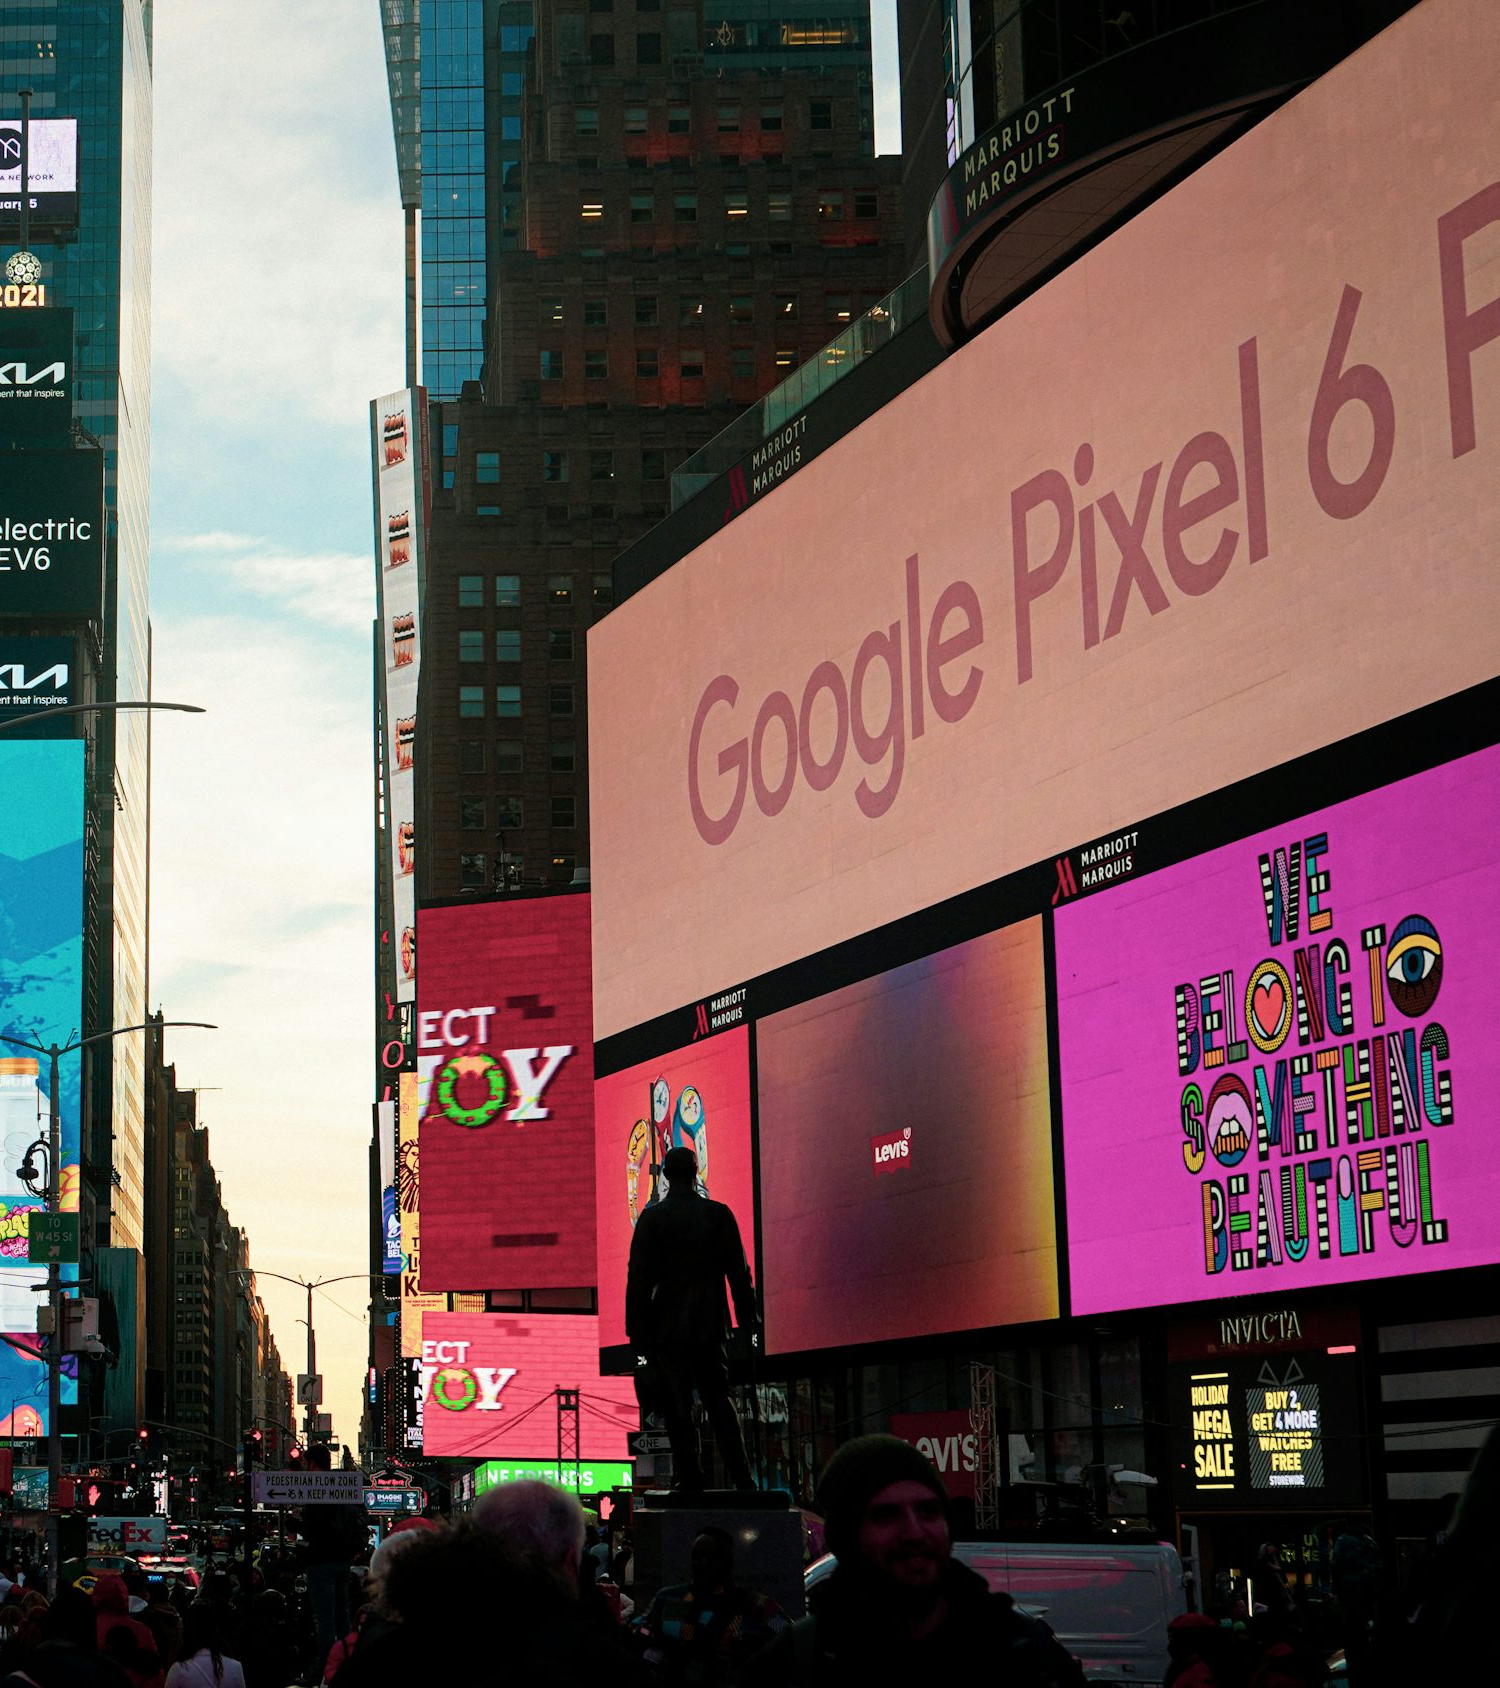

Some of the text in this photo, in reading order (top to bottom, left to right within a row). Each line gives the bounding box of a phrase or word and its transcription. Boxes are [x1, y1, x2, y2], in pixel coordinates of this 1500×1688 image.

[964, 88, 1076, 183] MARRIOTT
[8, 173, 55, 182] NEWORK
[966, 133, 1061, 217] MARQUIS
[29, 199, 38, 209] 5
[16, 390, 32, 398] that
[34, 389, 65, 399] inspires
[752, 415, 807, 471] MARRIOTT
[753, 446, 802, 494] MARQUIS
[687, 552, 985, 847] Google
[1010, 334, 1270, 686] Pixel
[1306, 282, 1397, 521] 6
[13, 695, 31, 705] that
[33, 695, 68, 707] inspires
[1081, 831, 1139, 867] MARRIOTT
[1082, 856, 1133, 888] MARQUIS
[1257, 832, 1332, 946] WE
[711, 988, 746, 1013] MARRIOTT
[1175, 914, 1444, 1077] BELONG TO
[711, 1006, 743, 1029] MARQUIS
[1181, 1022, 1454, 1174] SOMETHING
[1200, 1139, 1448, 1275] BEAUTIFUL
[48, 1218, 60, 1228] TO
[36, 1231, 73, 1242] W 45 St
[386, 1240, 400, 1249] TAC
[387, 1249, 401, 1258] BEL
[1220, 1310, 1302, 1346] INVICTA
[1190, 1384, 1229, 1407] HOLIDAY
[1265, 1390, 1302, 1411] BUY 2,
[1192, 1409, 1234, 1441] MEGA
[1252, 1409, 1318, 1431] GET 4 MORE
[639, 1438, 660, 1448] ONE
[1258, 1431, 1313, 1451] WATCHES
[1194, 1443, 1235, 1478] SALE
[1271, 1452, 1302, 1472] FREE
[266, 1476, 358, 1487] PEDESTRIAN FLOW ZONE
[1269, 1474, 1305, 1486] STOREWIDE
[307, 1489, 359, 1499] KEEP MOVING
